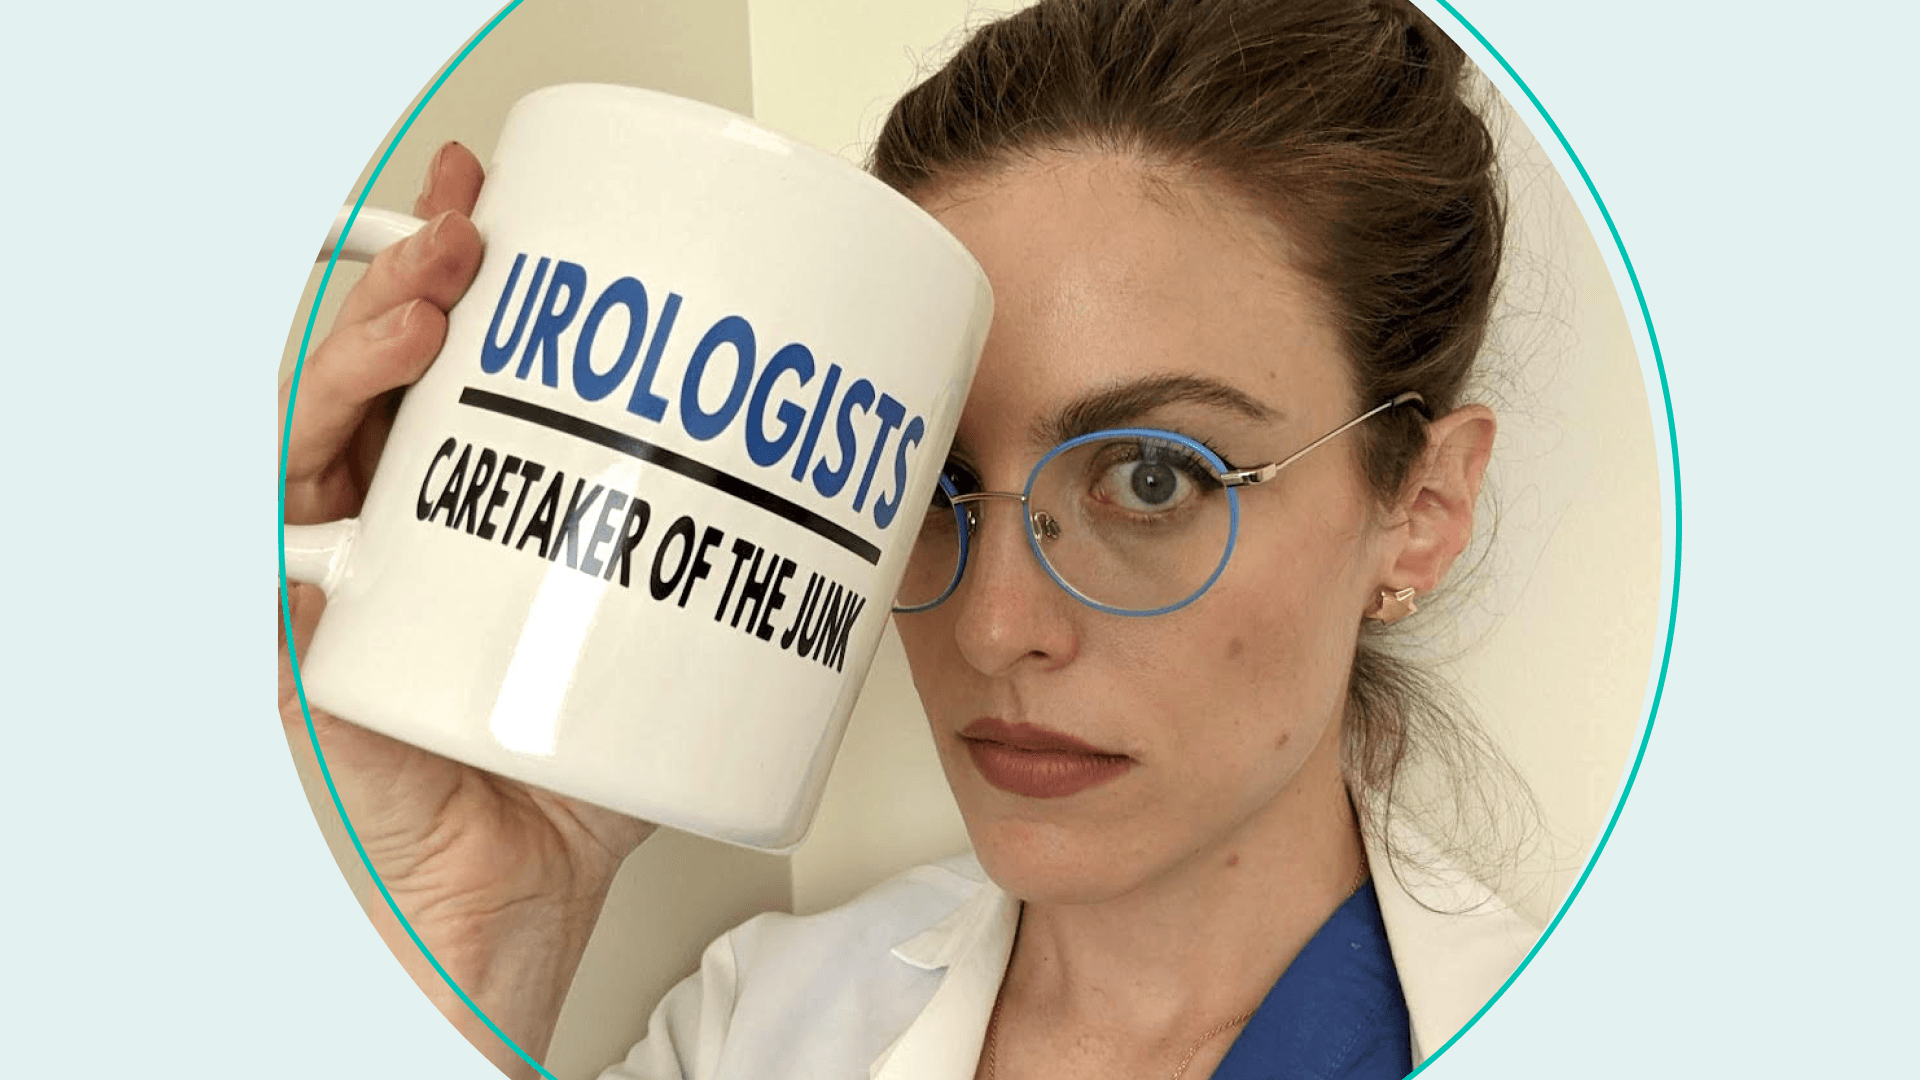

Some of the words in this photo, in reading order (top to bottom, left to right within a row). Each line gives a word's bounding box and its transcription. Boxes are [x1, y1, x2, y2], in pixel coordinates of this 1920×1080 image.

[480, 252, 925, 530] UROLOGISTS
[415, 436, 651, 588] CARETAKER
[649, 514, 725, 609] OF
[714, 537, 798, 642] THE
[780, 571, 867, 674] JUNK
